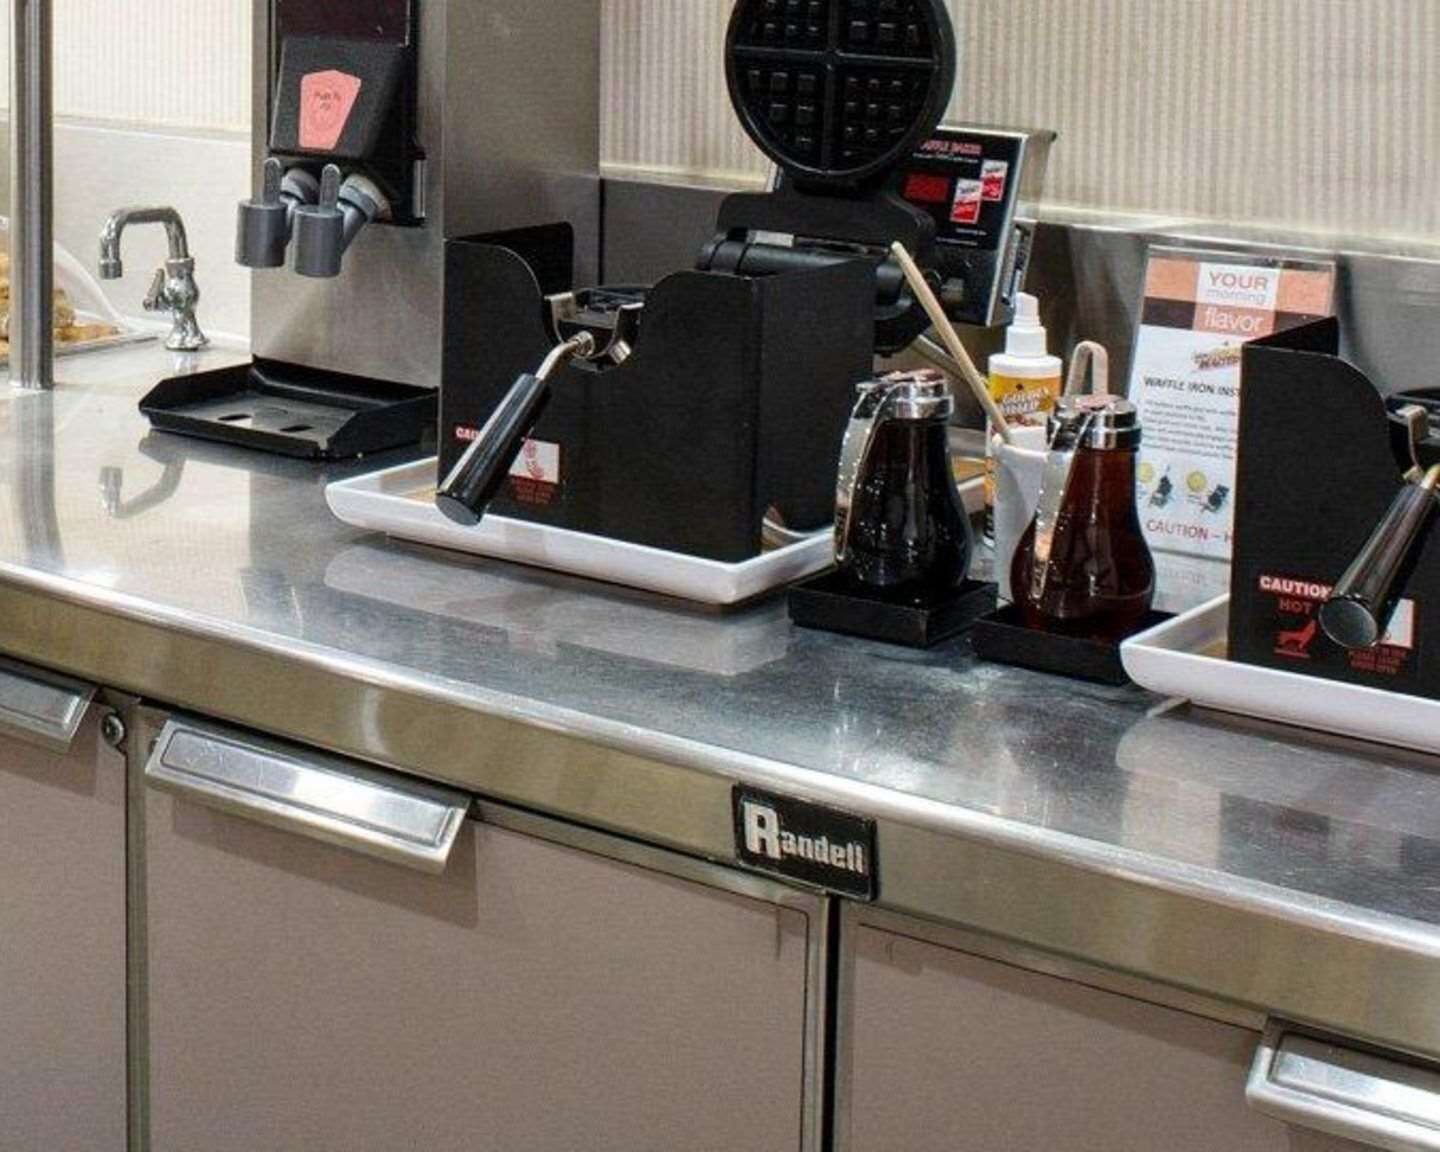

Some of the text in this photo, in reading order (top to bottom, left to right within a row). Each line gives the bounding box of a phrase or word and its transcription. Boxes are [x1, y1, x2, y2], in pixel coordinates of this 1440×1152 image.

[1209, 270, 1269, 290] YOUR
[1204, 307, 1264, 333] flavor
[1144, 375, 1185, 391] WAFFLE
[1187, 381, 1216, 395] IRON
[1146, 519, 1209, 540] CAUTION
[1259, 575, 1333, 600] CAUTION
[1278, 598, 1311, 615] HOT
[743, 800, 864, 875] Randell
